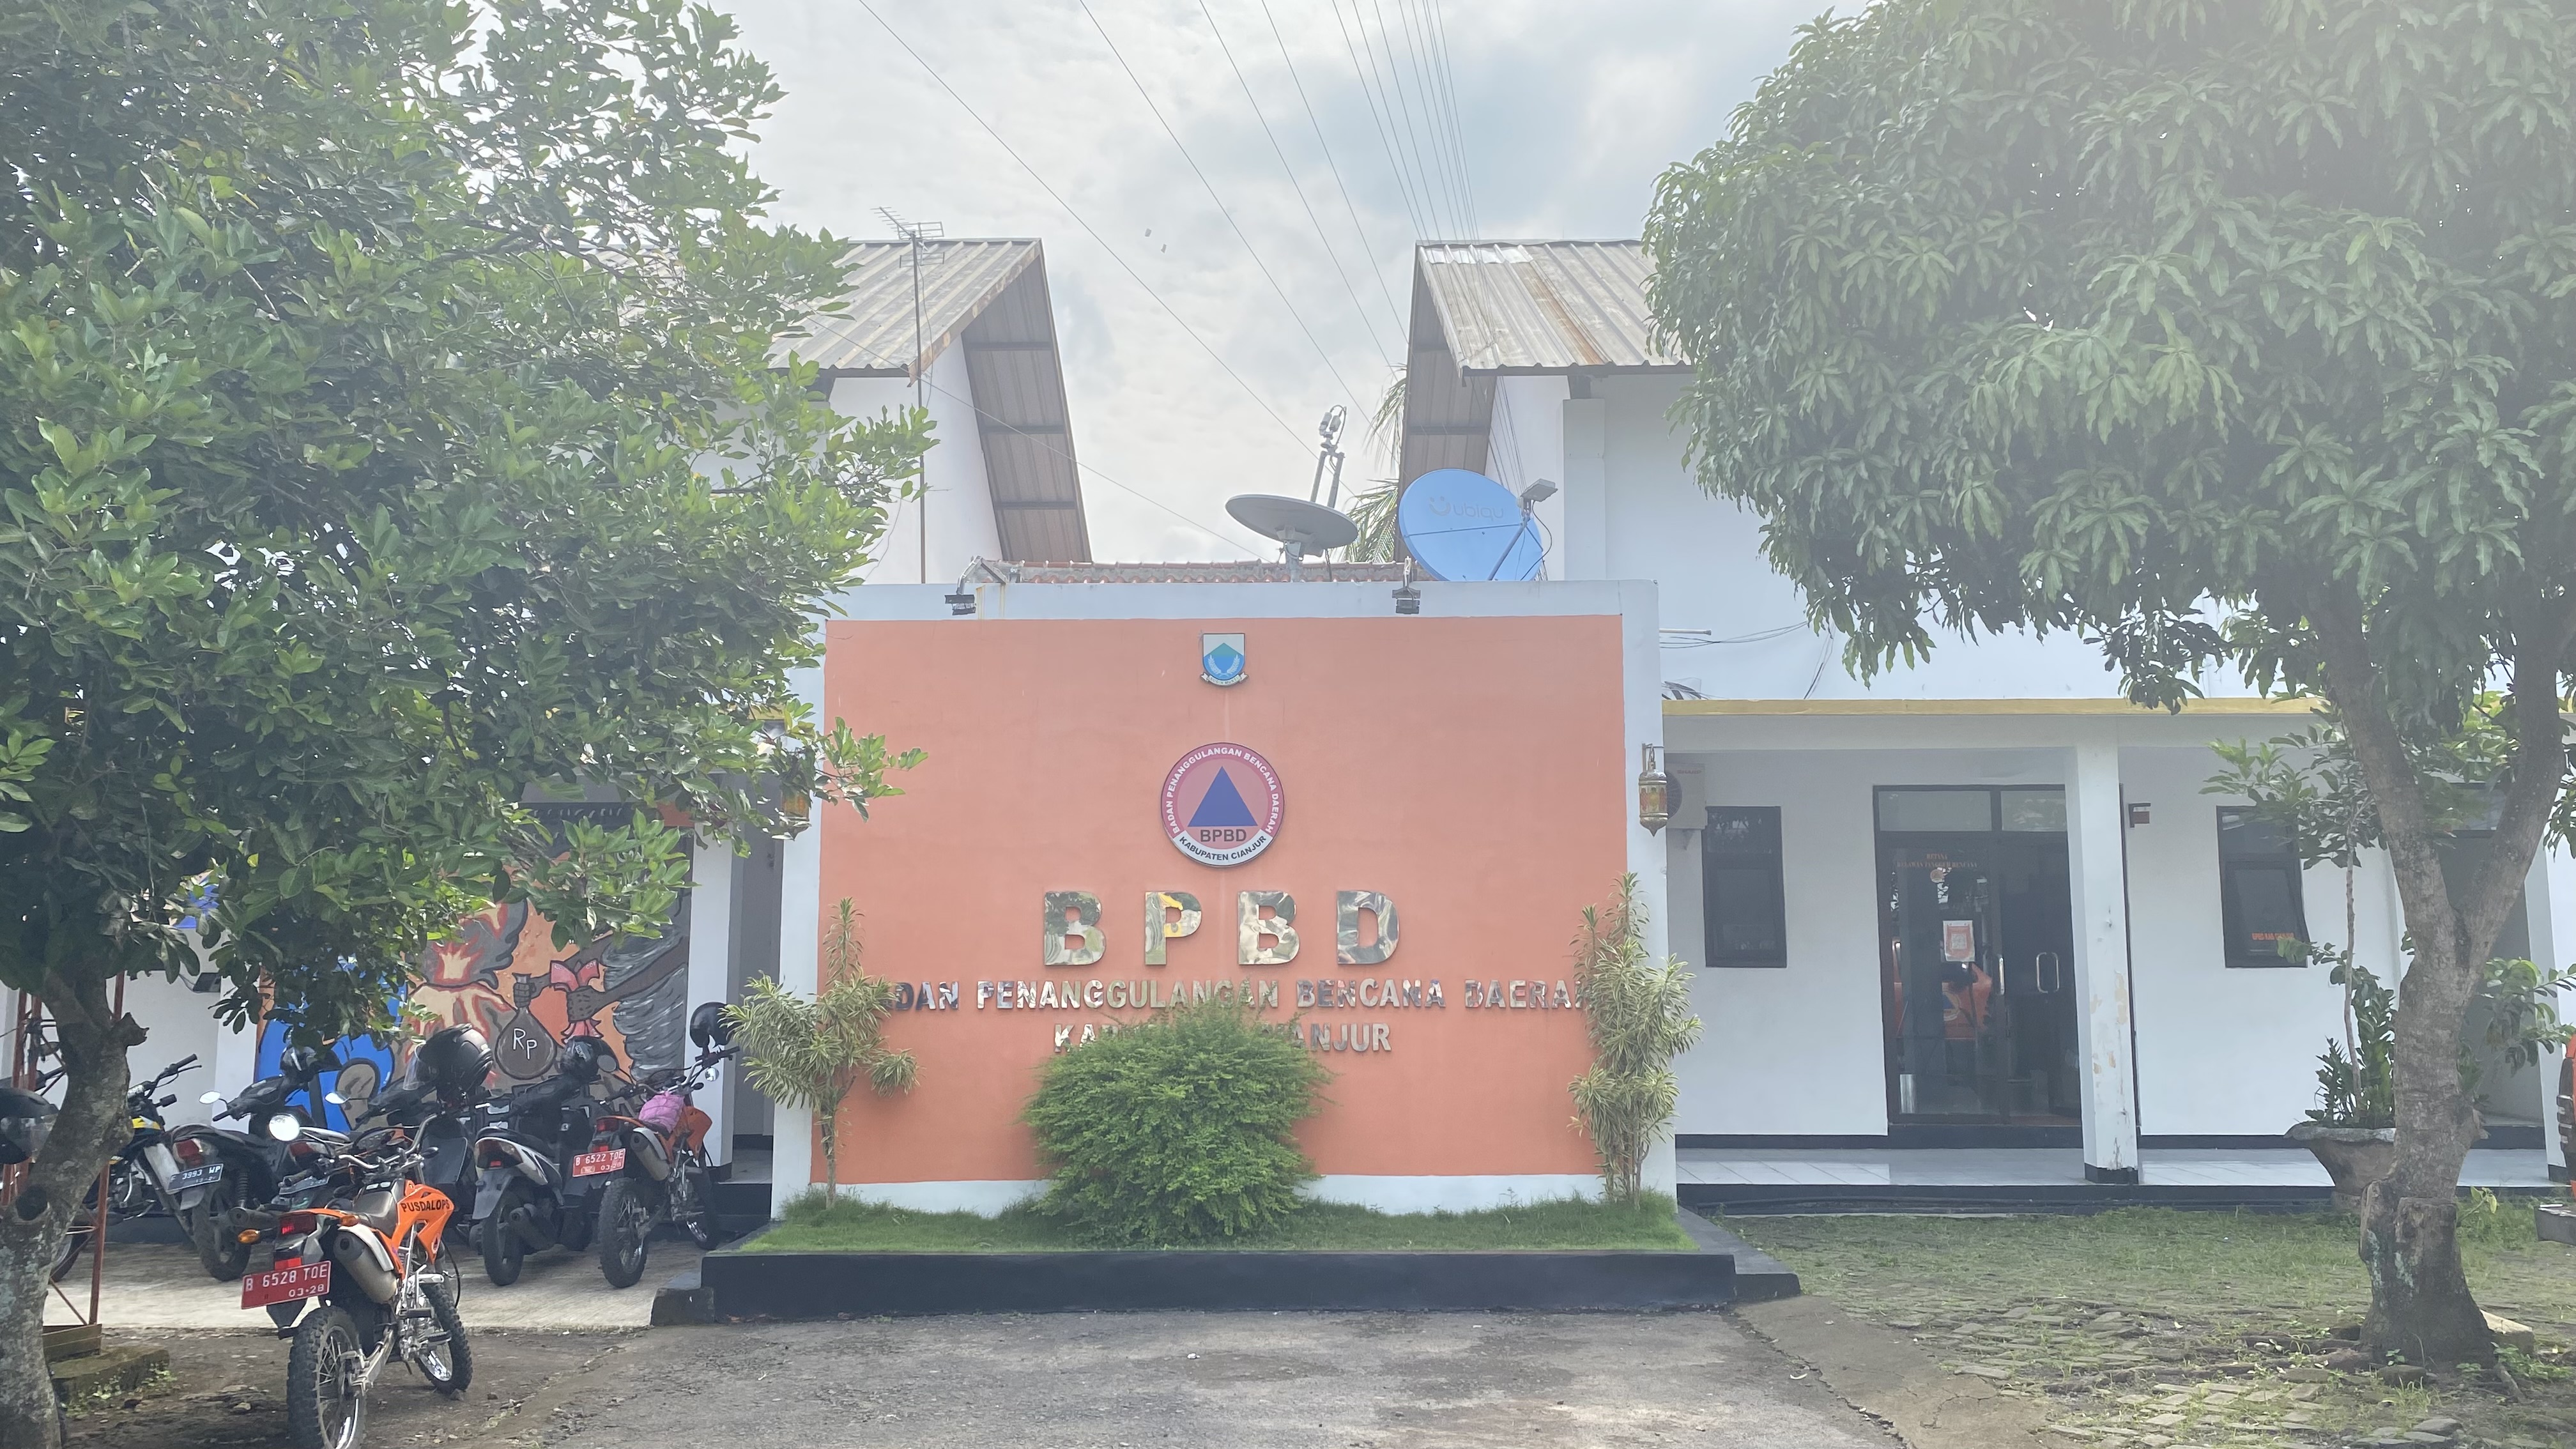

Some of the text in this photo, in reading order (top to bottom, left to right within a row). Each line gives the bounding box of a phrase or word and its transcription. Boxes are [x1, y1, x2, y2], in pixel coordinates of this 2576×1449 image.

[1166, 747, 1279, 834] BADAN PENANGGULANGAN BENCANA DAERAH
[1200, 829, 1246, 842] BPBD
[1179, 836, 1266, 861] KABUPATEN CIANJUR
[977, 979, 1278, 1010] PENANGGULANGAN
[1296, 977, 1446, 1008] BENCANA
[576, 1150, 624, 1166] B 6522 TOE
[182, 1169, 203, 1180] 3993
[208, 1165, 221, 1174] WP
[400, 1199, 450, 1213] PUSDALOPS
[245, 1264, 327, 1291] B 6528 TOE
